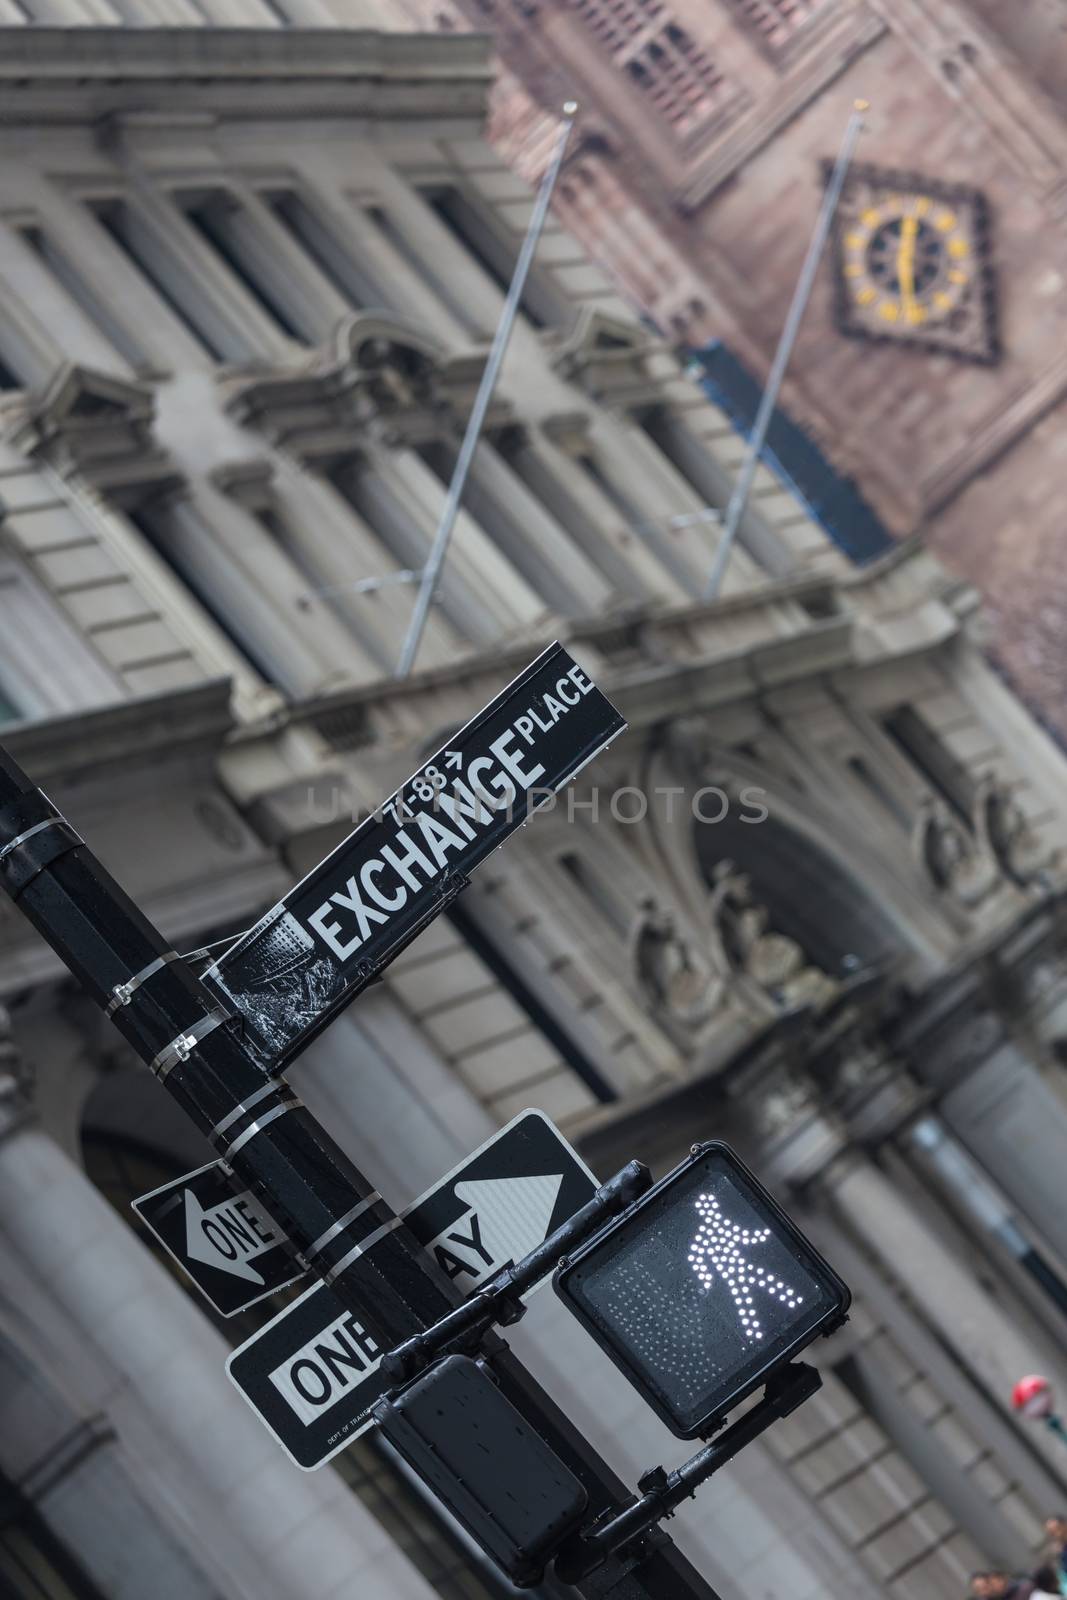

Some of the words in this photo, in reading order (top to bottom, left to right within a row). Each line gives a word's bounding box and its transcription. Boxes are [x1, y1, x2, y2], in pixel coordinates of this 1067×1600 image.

[308, 728, 546, 962] EXCHANGE
[513, 664, 596, 746] PLACE
[382, 766, 447, 828] 71-88
[201, 1200, 275, 1261] ONE
[433, 1213, 495, 1280] AY
[290, 1319, 383, 1406] ONE
[342, 1424, 350, 1433] OF
